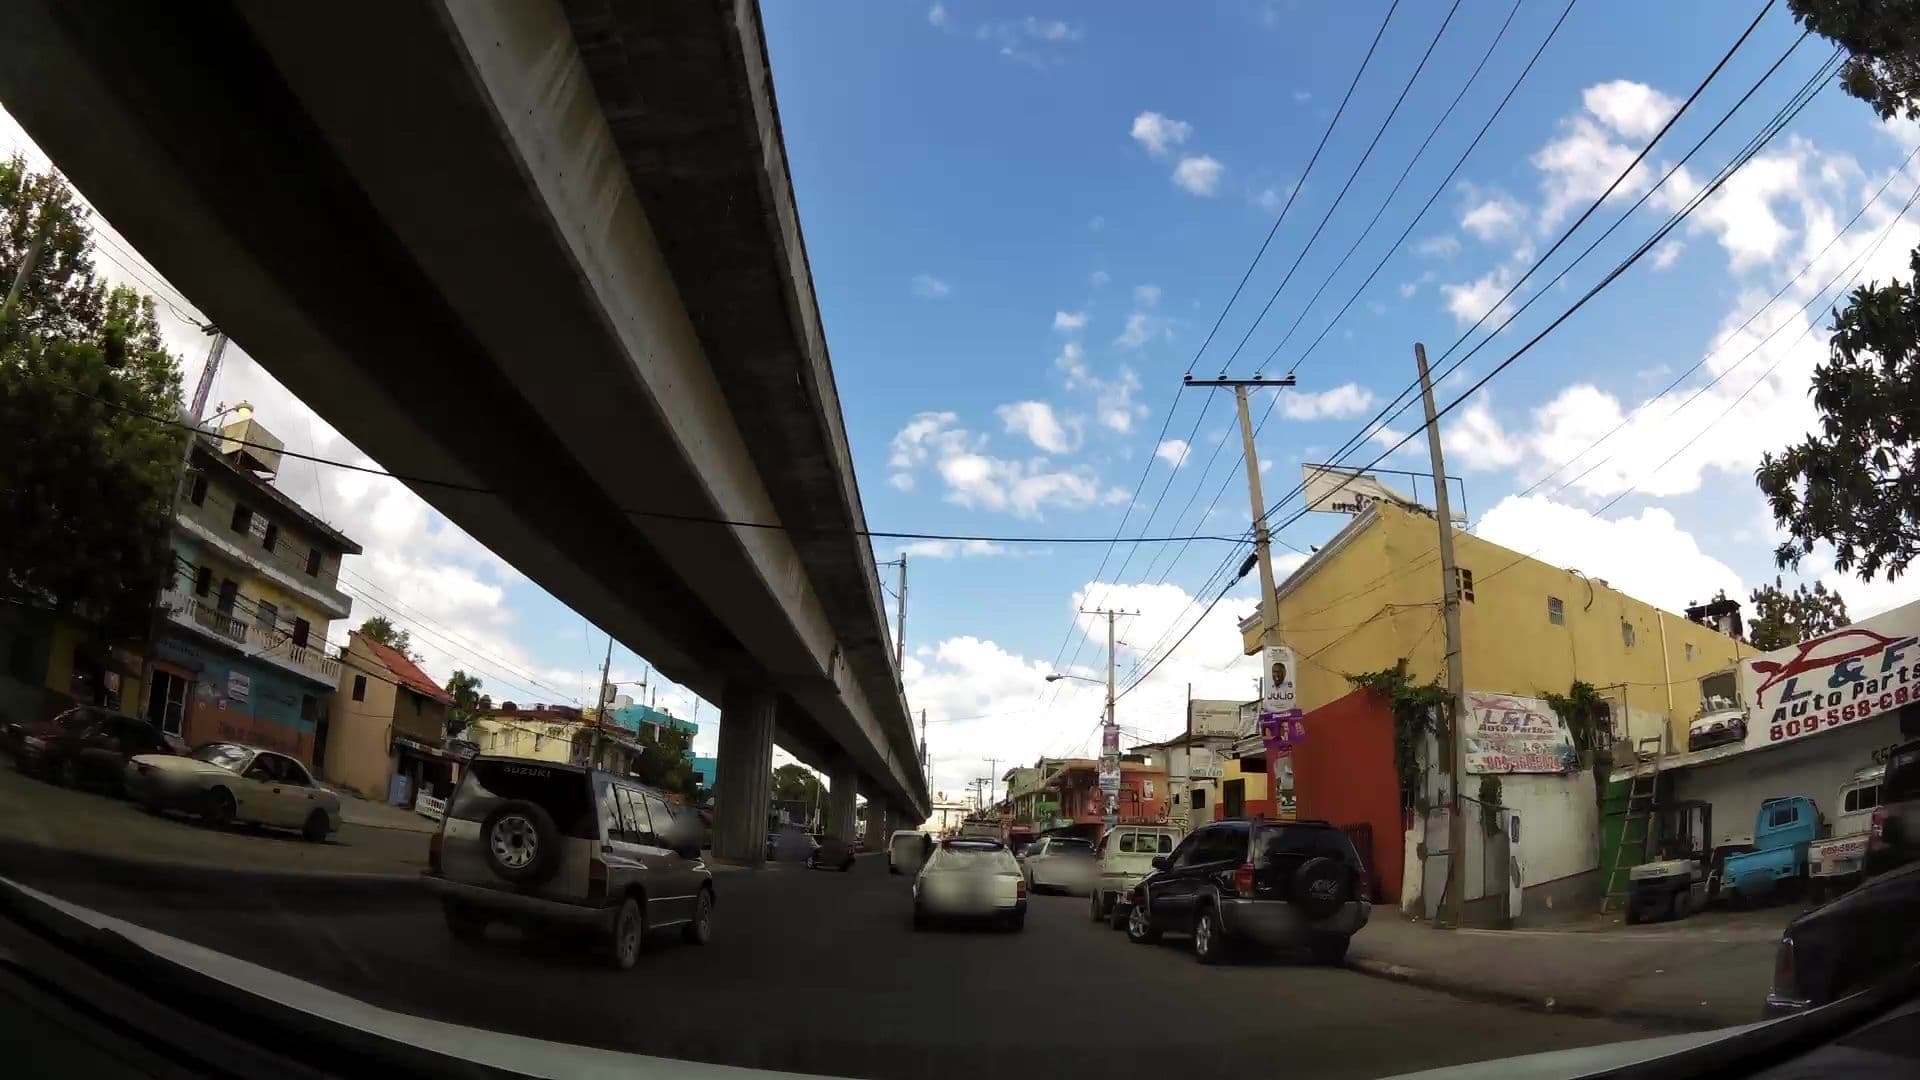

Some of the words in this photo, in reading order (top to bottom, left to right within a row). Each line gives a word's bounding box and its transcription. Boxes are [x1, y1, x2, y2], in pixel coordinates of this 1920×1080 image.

[1780, 677, 1813, 705] L
[1828, 657, 1867, 689] &
[1880, 636, 1919, 673] F
[1267, 691, 1294, 700] JULIO
[1771, 690, 1842, 723] Auto
[1483, 709, 1498, 725] L
[1479, 724, 1508, 734] Auto
